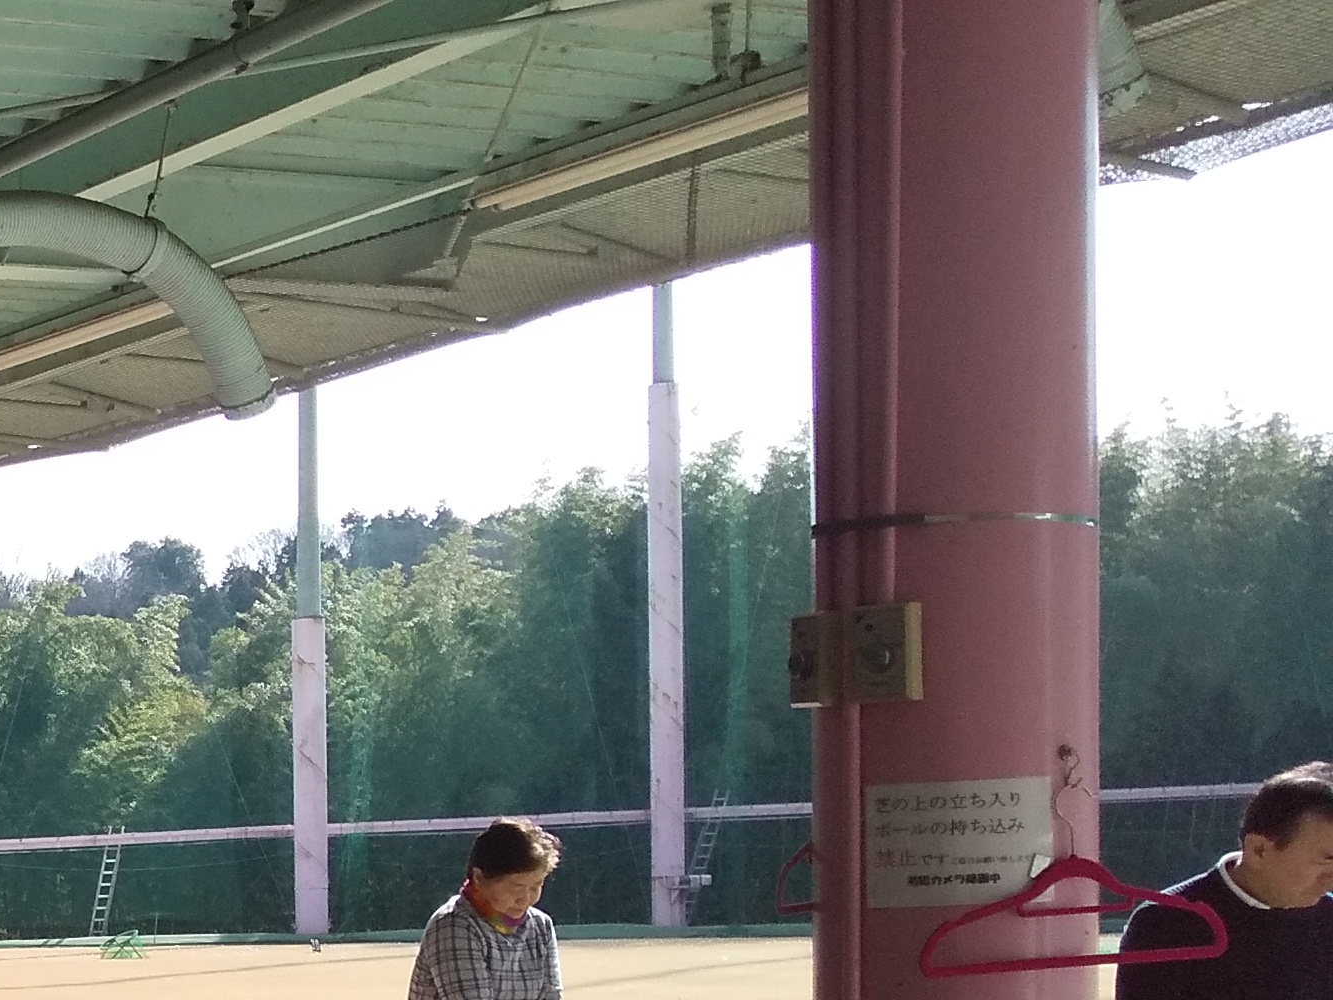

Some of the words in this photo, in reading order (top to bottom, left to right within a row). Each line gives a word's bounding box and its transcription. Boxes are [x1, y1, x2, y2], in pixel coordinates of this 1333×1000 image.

[875, 818, 1025, 838] ボールの持ち込み
